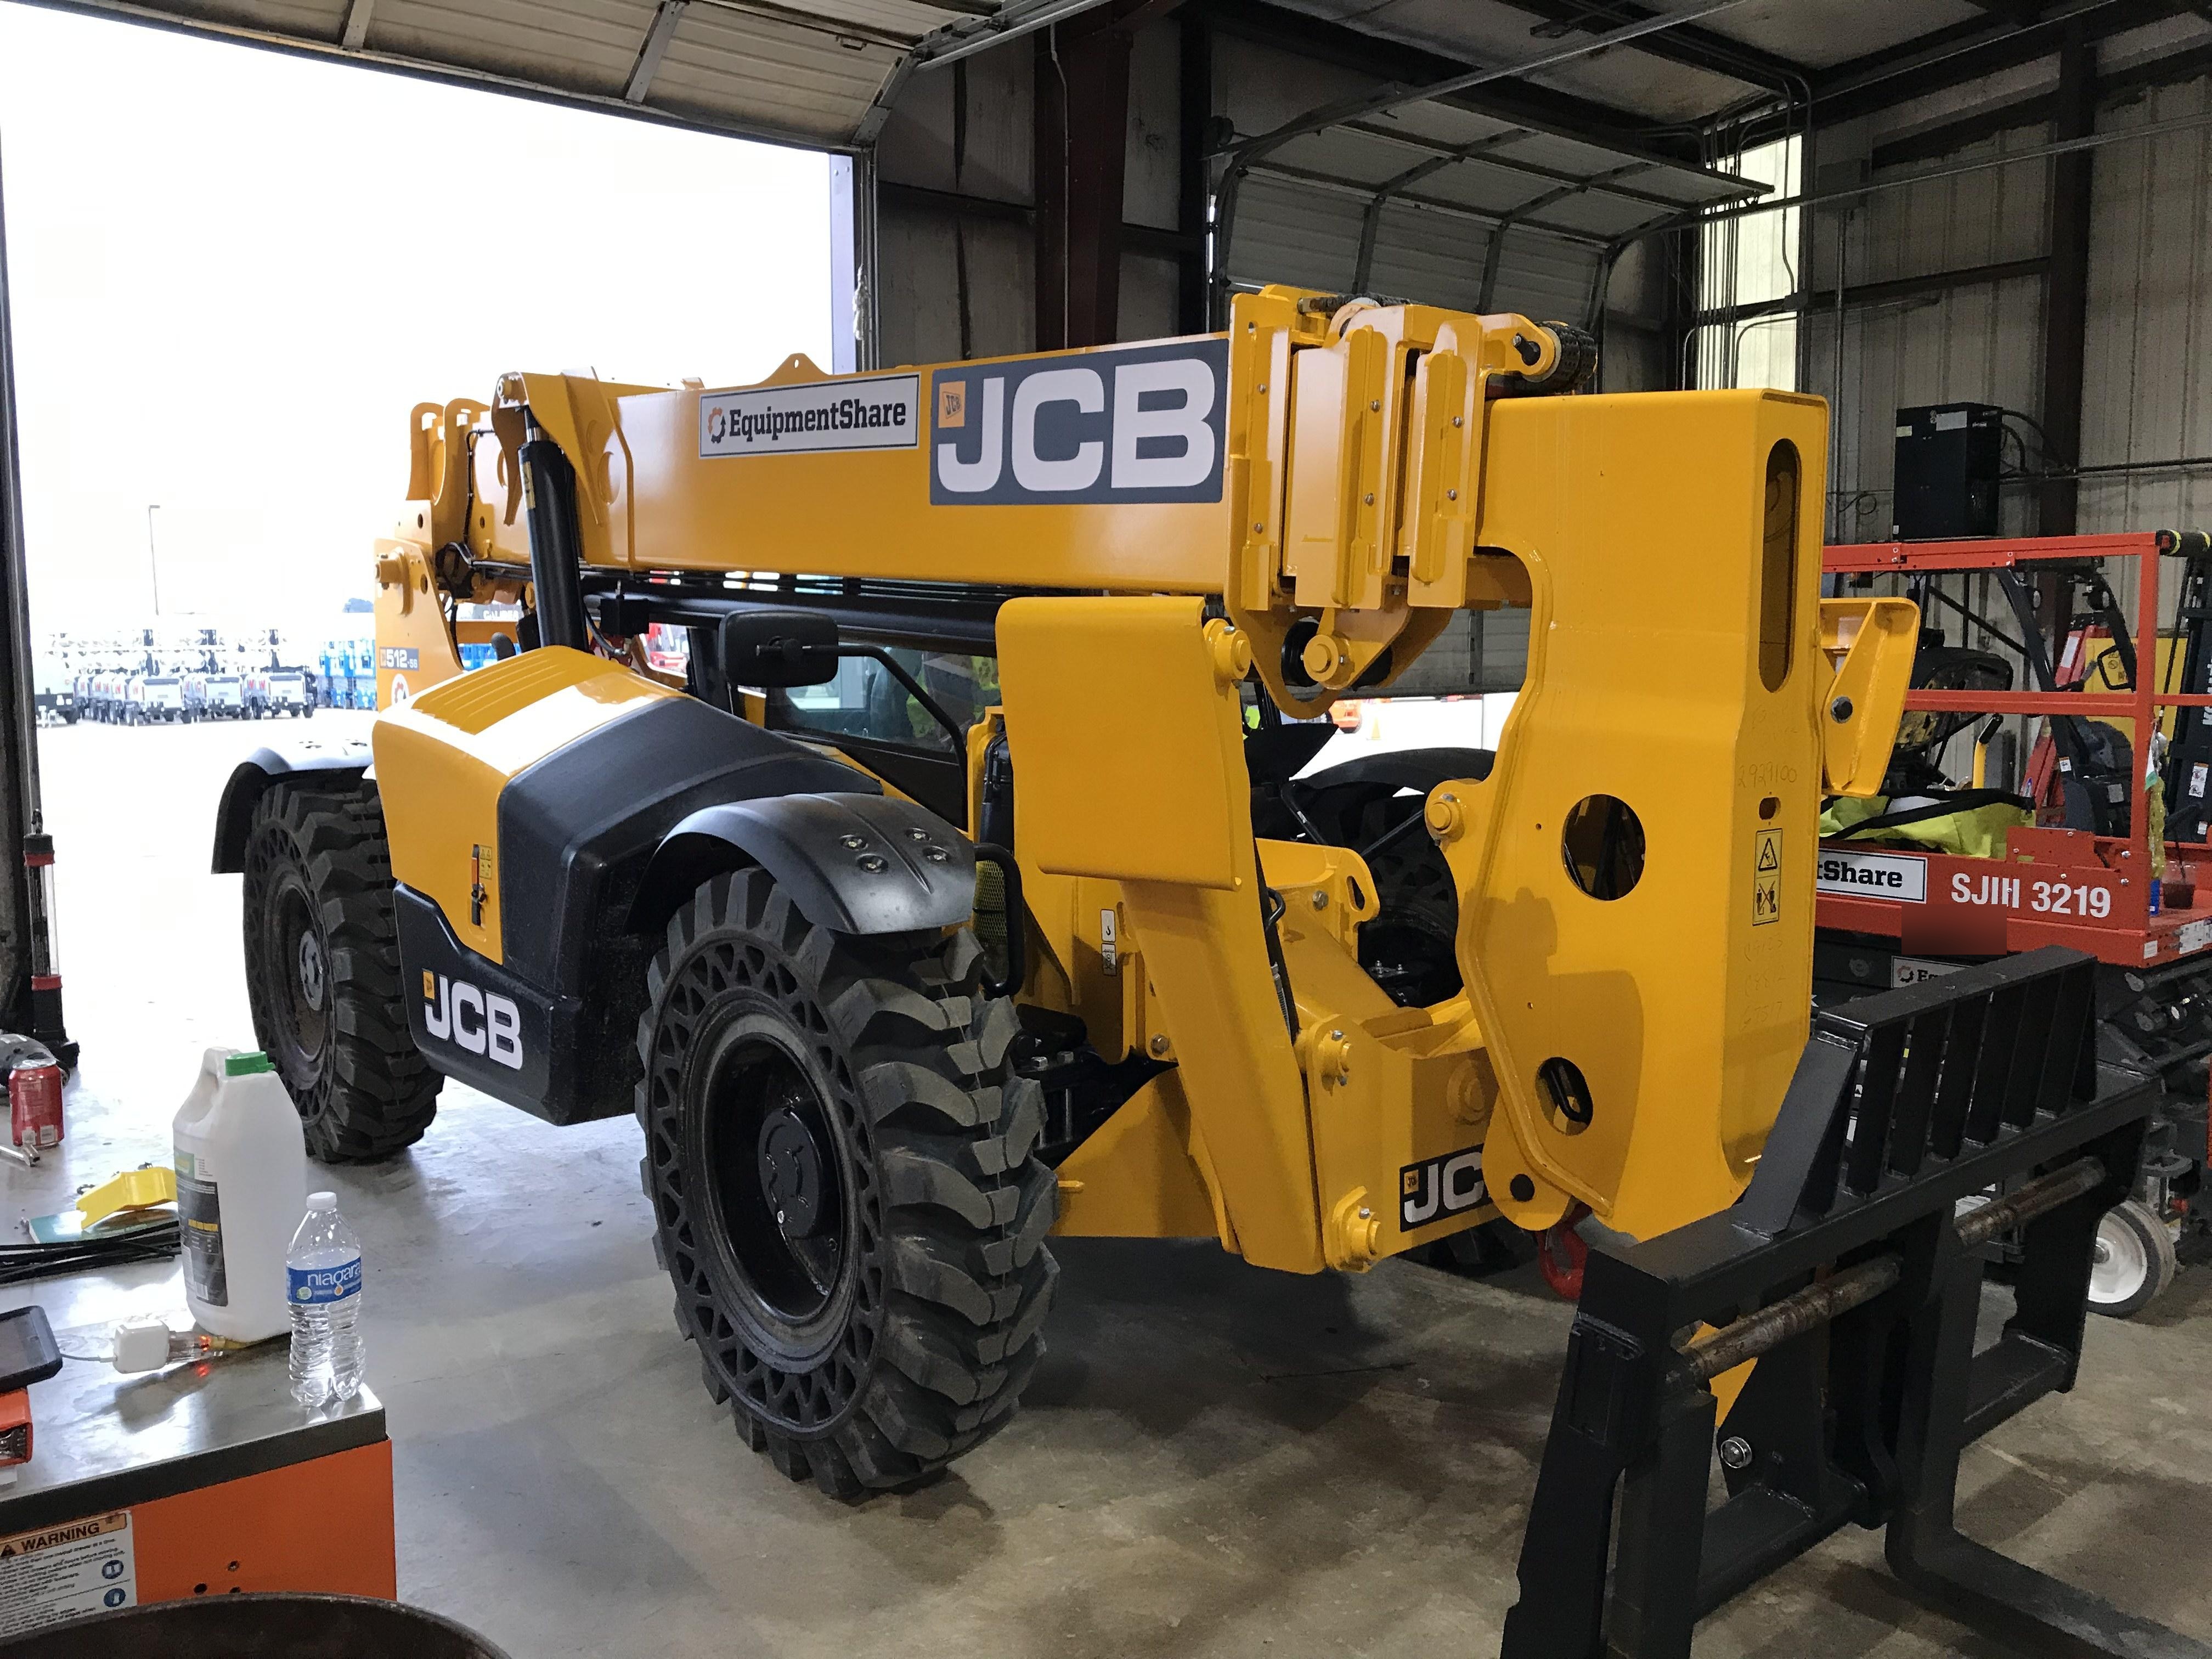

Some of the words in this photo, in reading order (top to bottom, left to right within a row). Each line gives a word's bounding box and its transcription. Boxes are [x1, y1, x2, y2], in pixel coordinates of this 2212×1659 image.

[729, 398, 906, 442] EquipmentShare
[946, 394, 961, 415] JCB
[938, 359, 1215, 492] JCB
[2031, 881, 2111, 918] 3219
[424, 974, 523, 1070] JCB
[1404, 1152, 1485, 1223] JC
[307, 1262, 362, 1287] niagara
[20, 1522, 100, 1551] WARNING
